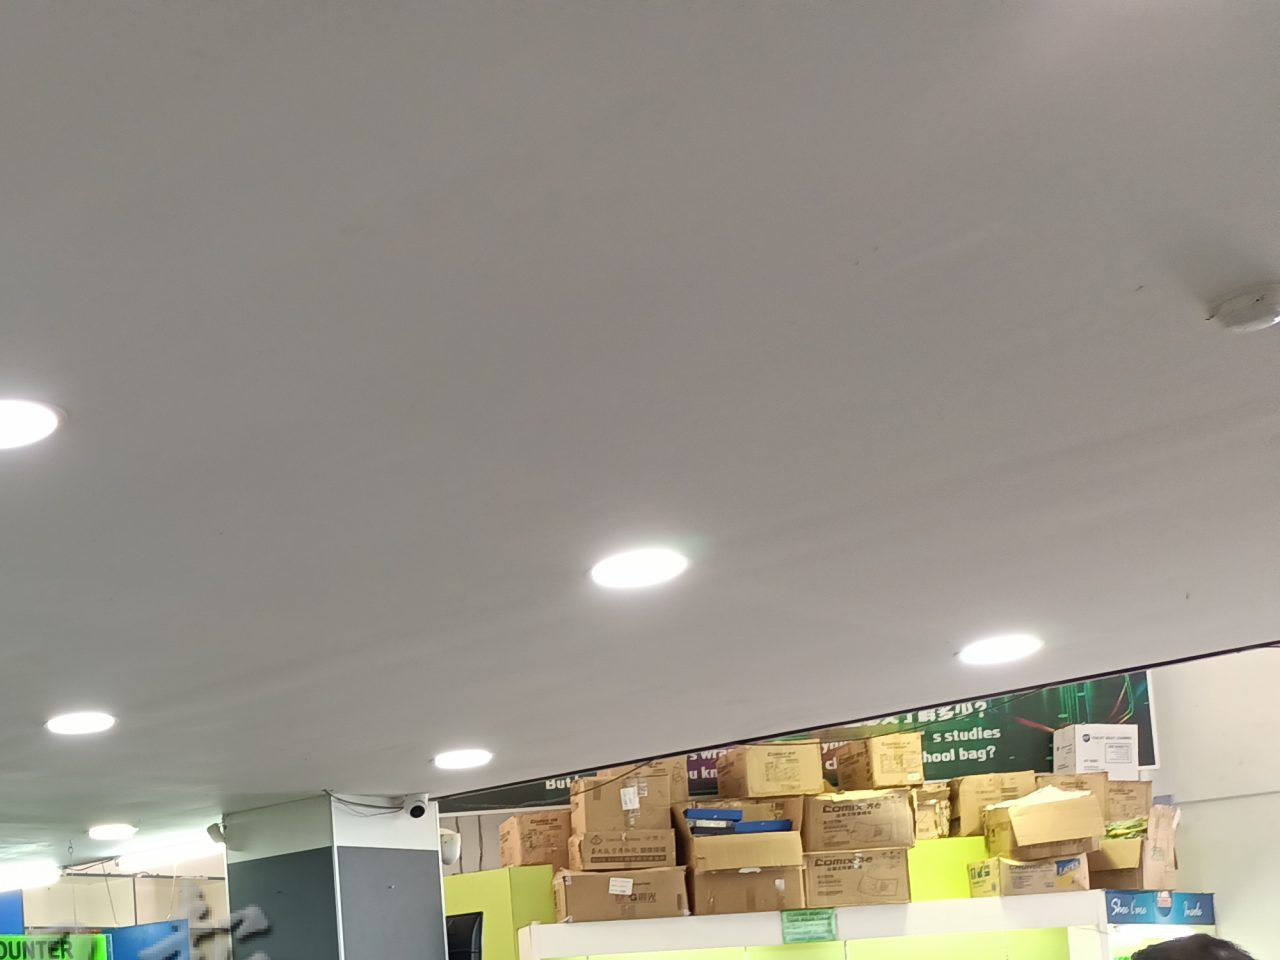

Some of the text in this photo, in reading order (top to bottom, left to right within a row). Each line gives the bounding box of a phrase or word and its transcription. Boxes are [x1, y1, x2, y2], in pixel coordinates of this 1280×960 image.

[944, 727, 1001, 742] studies
[923, 749, 956, 762] hool
[958, 745, 996, 762] bag?
[822, 803, 862, 814] Comix
